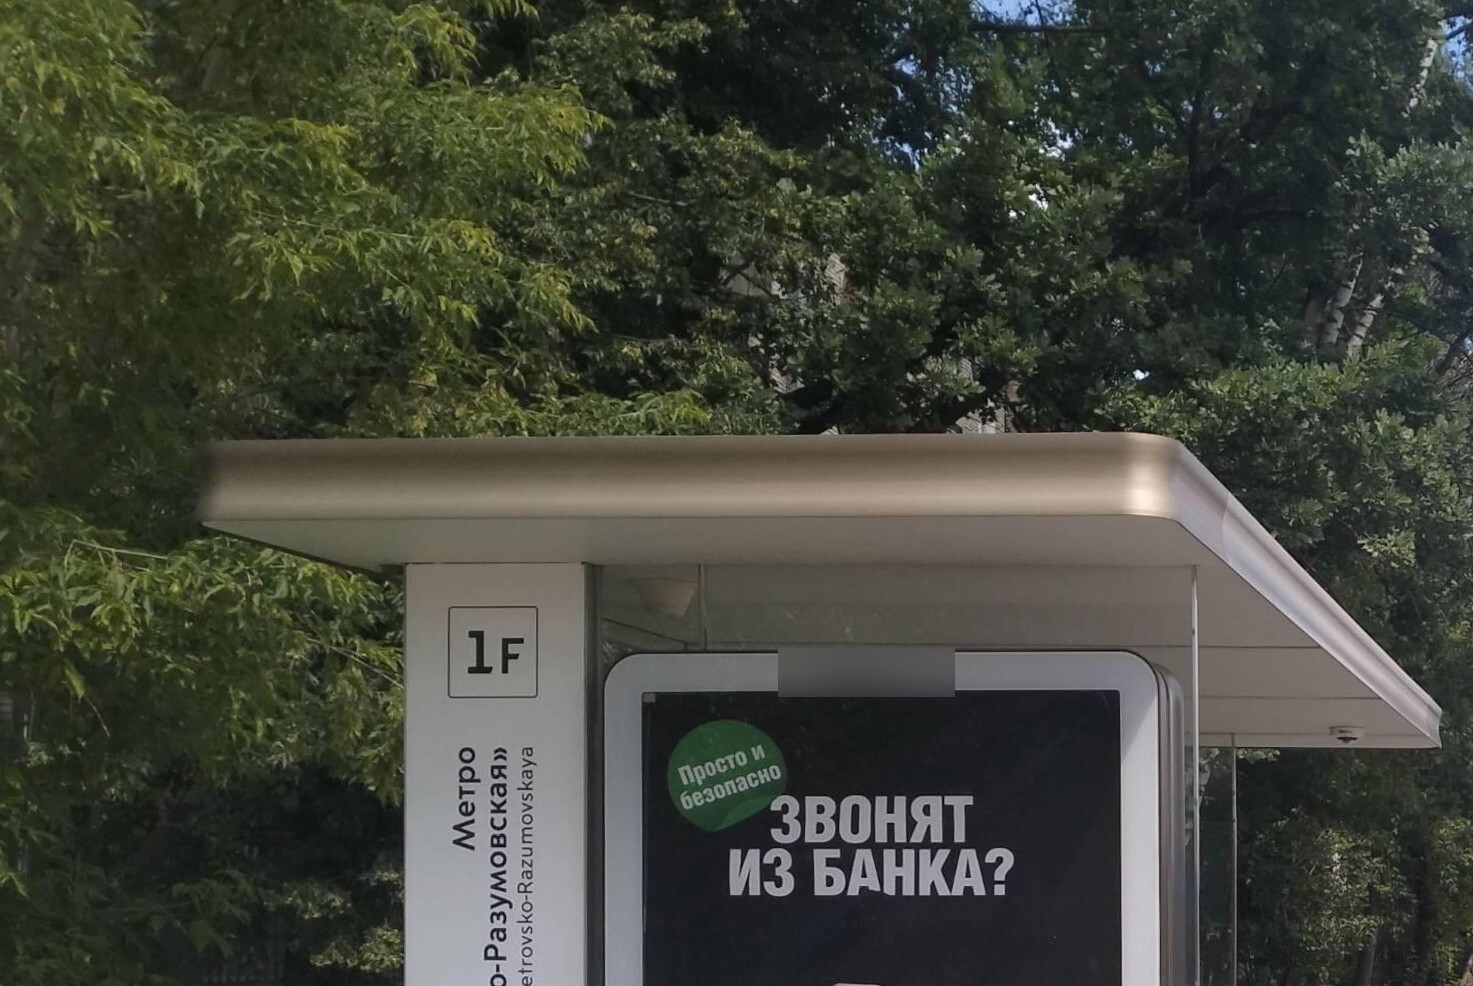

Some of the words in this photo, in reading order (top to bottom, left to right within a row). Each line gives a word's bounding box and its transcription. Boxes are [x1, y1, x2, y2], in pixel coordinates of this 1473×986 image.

[467, 630, 524, 674] 1F
[678, 751, 748, 786] Просто
[750, 744, 766, 762] и
[680, 764, 782, 811] безопасно
[452, 746, 481, 851] Метро
[770, 794, 974, 844] ЗВОНЯТ
[729, 848, 795, 897] ИЗ
[813, 847, 1015, 897] БАНКА?
